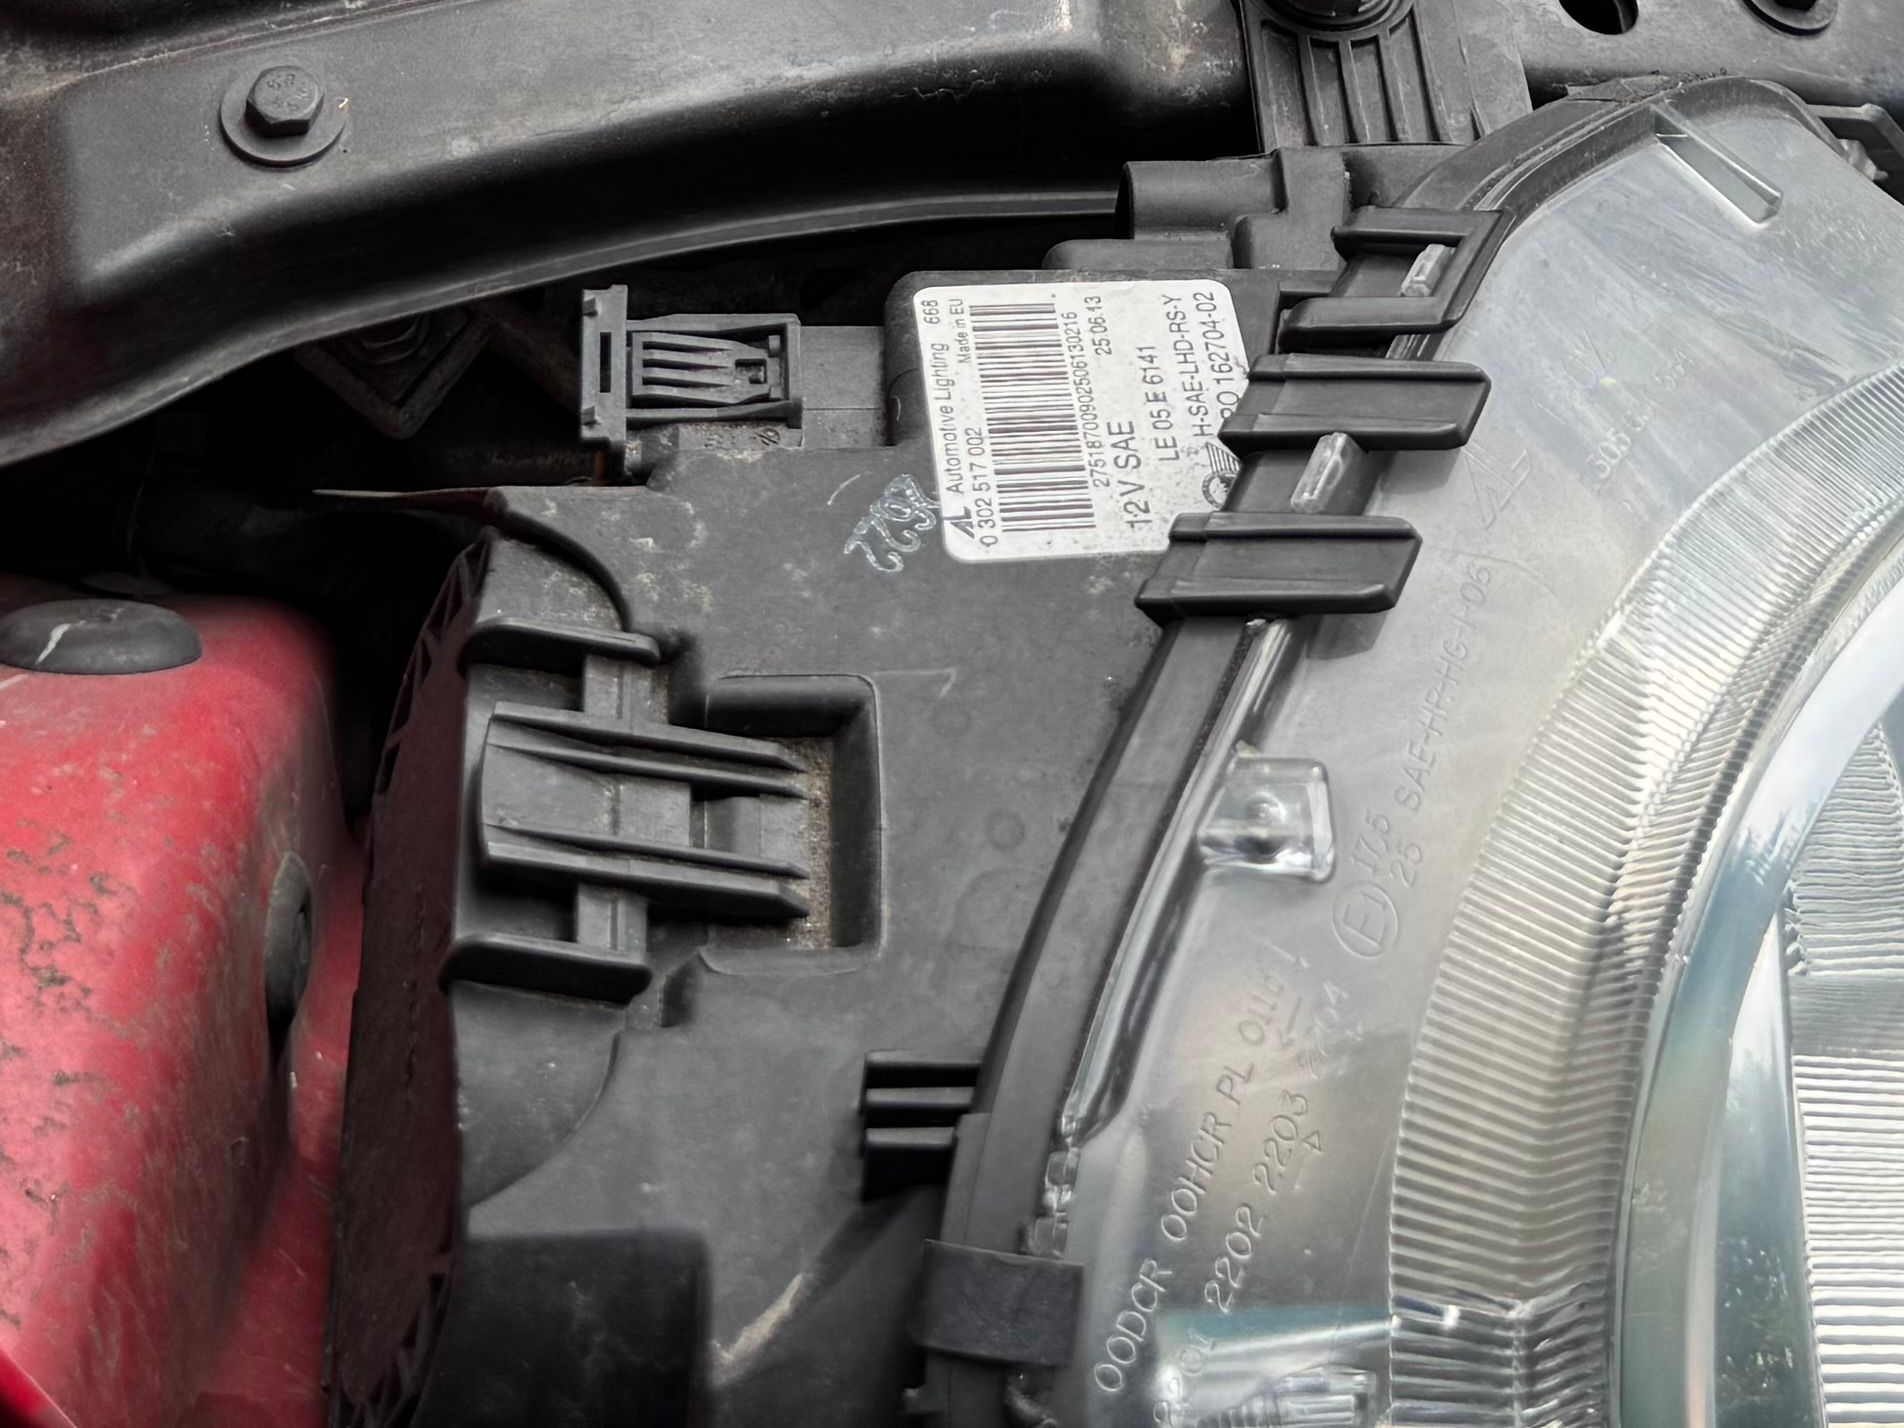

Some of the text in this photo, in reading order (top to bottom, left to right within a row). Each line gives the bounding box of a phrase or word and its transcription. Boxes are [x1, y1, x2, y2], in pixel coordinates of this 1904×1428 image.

[921, 299, 941, 324] 668
[948, 299, 971, 364] Made in EU
[1084, 295, 1112, 356] 25.06.13
[1193, 291, 1235, 385] 162704-02
[930, 343, 955, 400] Lighting
[1135, 346, 1180, 462] LE 05 E 6141
[1162, 294, 1213, 437] H-SAE-LHD-RS-Y
[939, 405, 964, 494] Automotive
[964, 427, 999, 547] 0 302 517 002
[1107, 420, 1153, 534] 12 V SAE
[1215, 1061, 1255, 1107] PL
[1204, 1203, 1267, 1314] 2202
[1252, 1088, 1309, 1197] 2203
